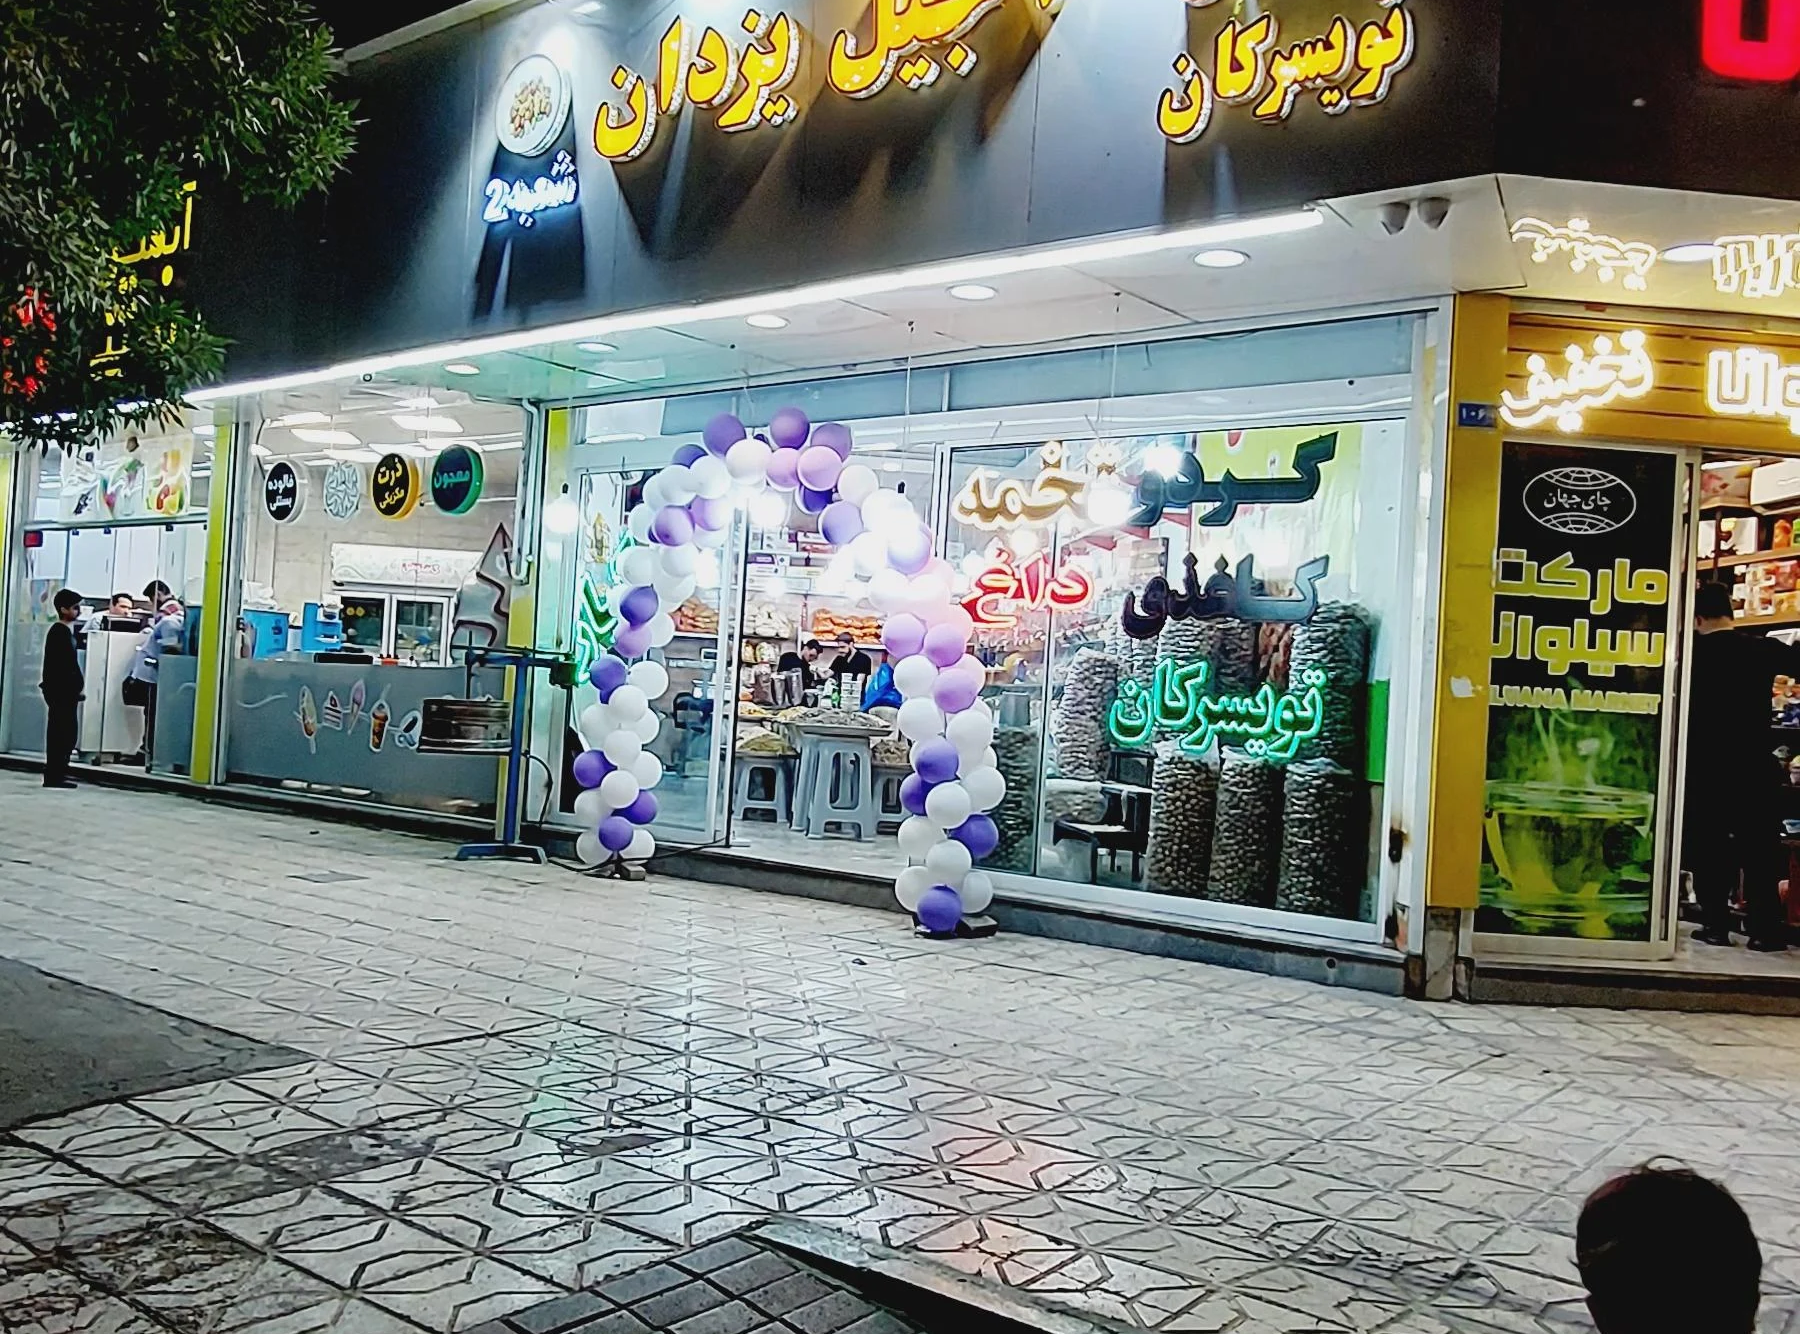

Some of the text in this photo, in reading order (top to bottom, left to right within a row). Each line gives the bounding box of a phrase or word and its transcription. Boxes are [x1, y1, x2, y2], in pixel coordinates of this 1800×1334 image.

[594, 9, 800, 161] یزدان
[1500, 330, 1653, 432] تخفیف
[268, 474, 294, 494] فالوده
[377, 457, 403, 486] ذرت
[379, 488, 405, 509] مکزیکی
[433, 469, 471, 488] معجون
[1127, 431, 1339, 526] گردو
[1543, 488, 1611, 511] چای جهان
[958, 545, 1095, 629] داغ
[1120, 552, 1330, 639] کاغذی
[1494, 548, 1668, 614] مارکت
[1491, 611, 1665, 676] سیلوان
[1108, 657, 1327, 758] تویسرکان
